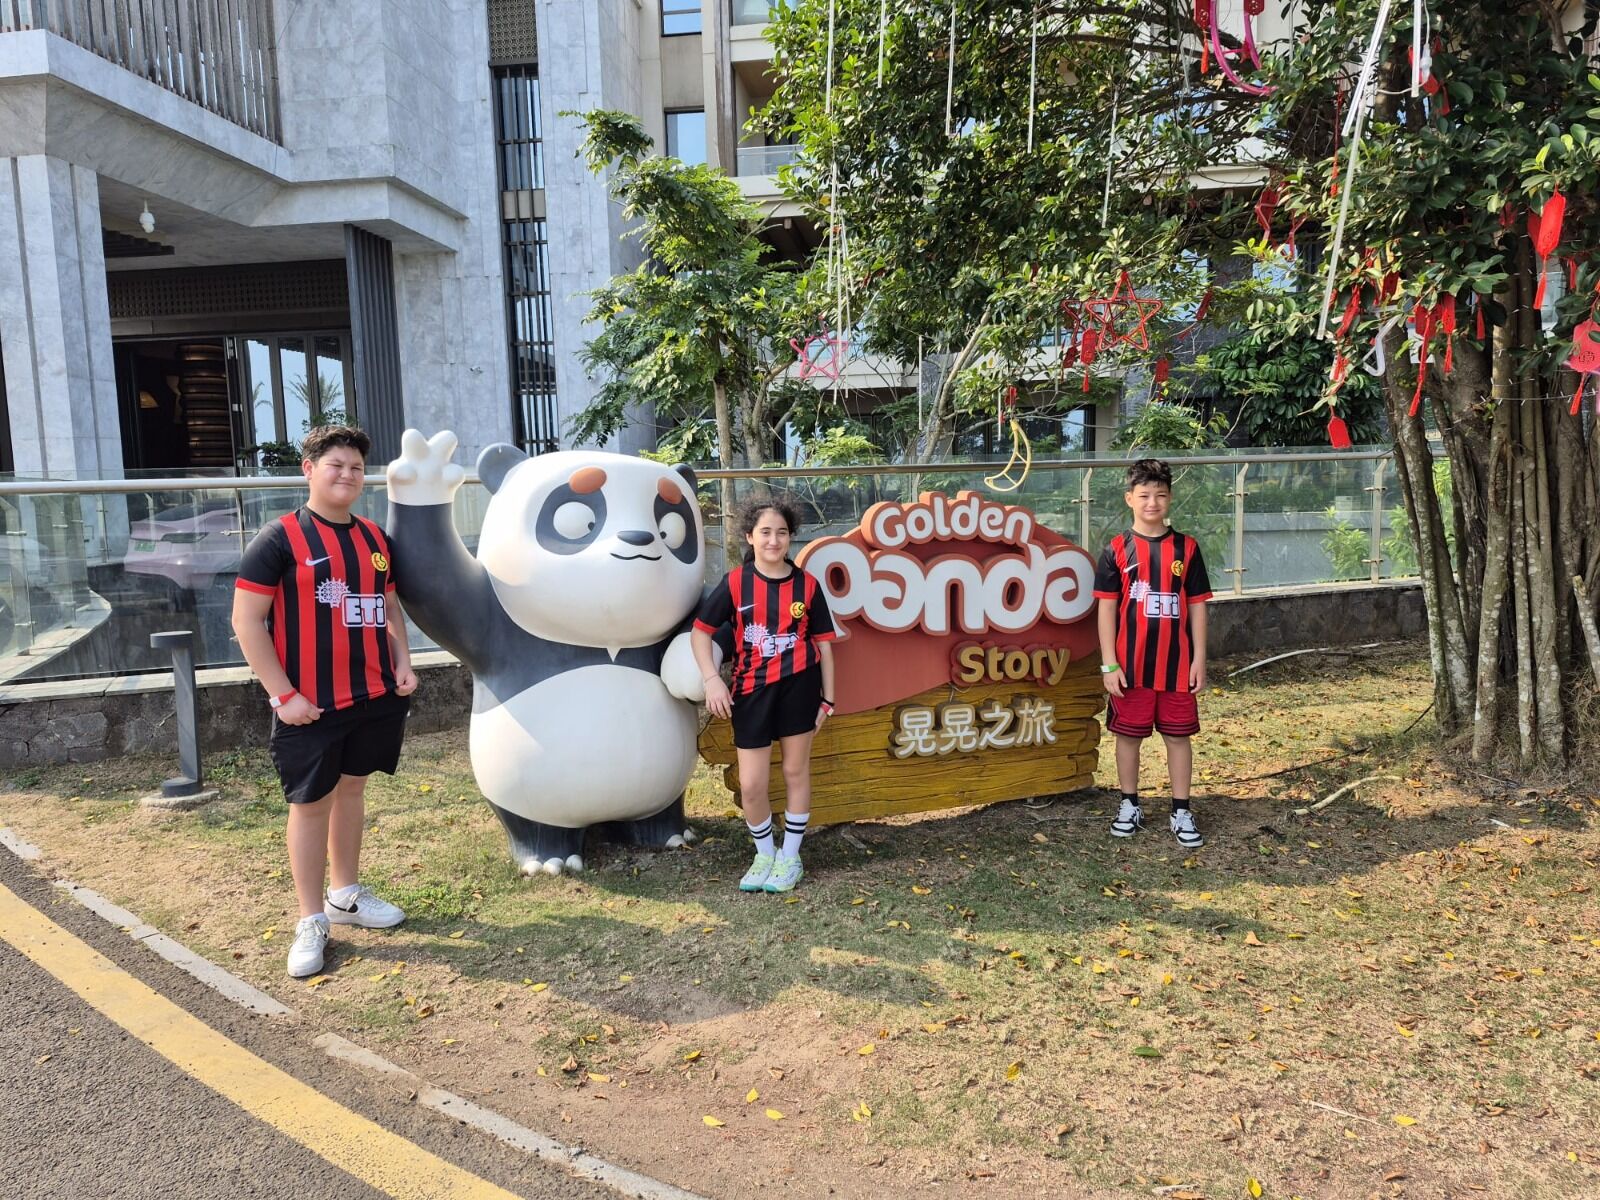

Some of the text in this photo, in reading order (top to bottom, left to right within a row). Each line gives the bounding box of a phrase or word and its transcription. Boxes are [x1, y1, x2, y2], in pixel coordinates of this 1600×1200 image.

[874, 497, 1032, 546] Golden
[960, 646, 1070, 686] Story
[899, 702, 1056, 755] 晃晃之旅
